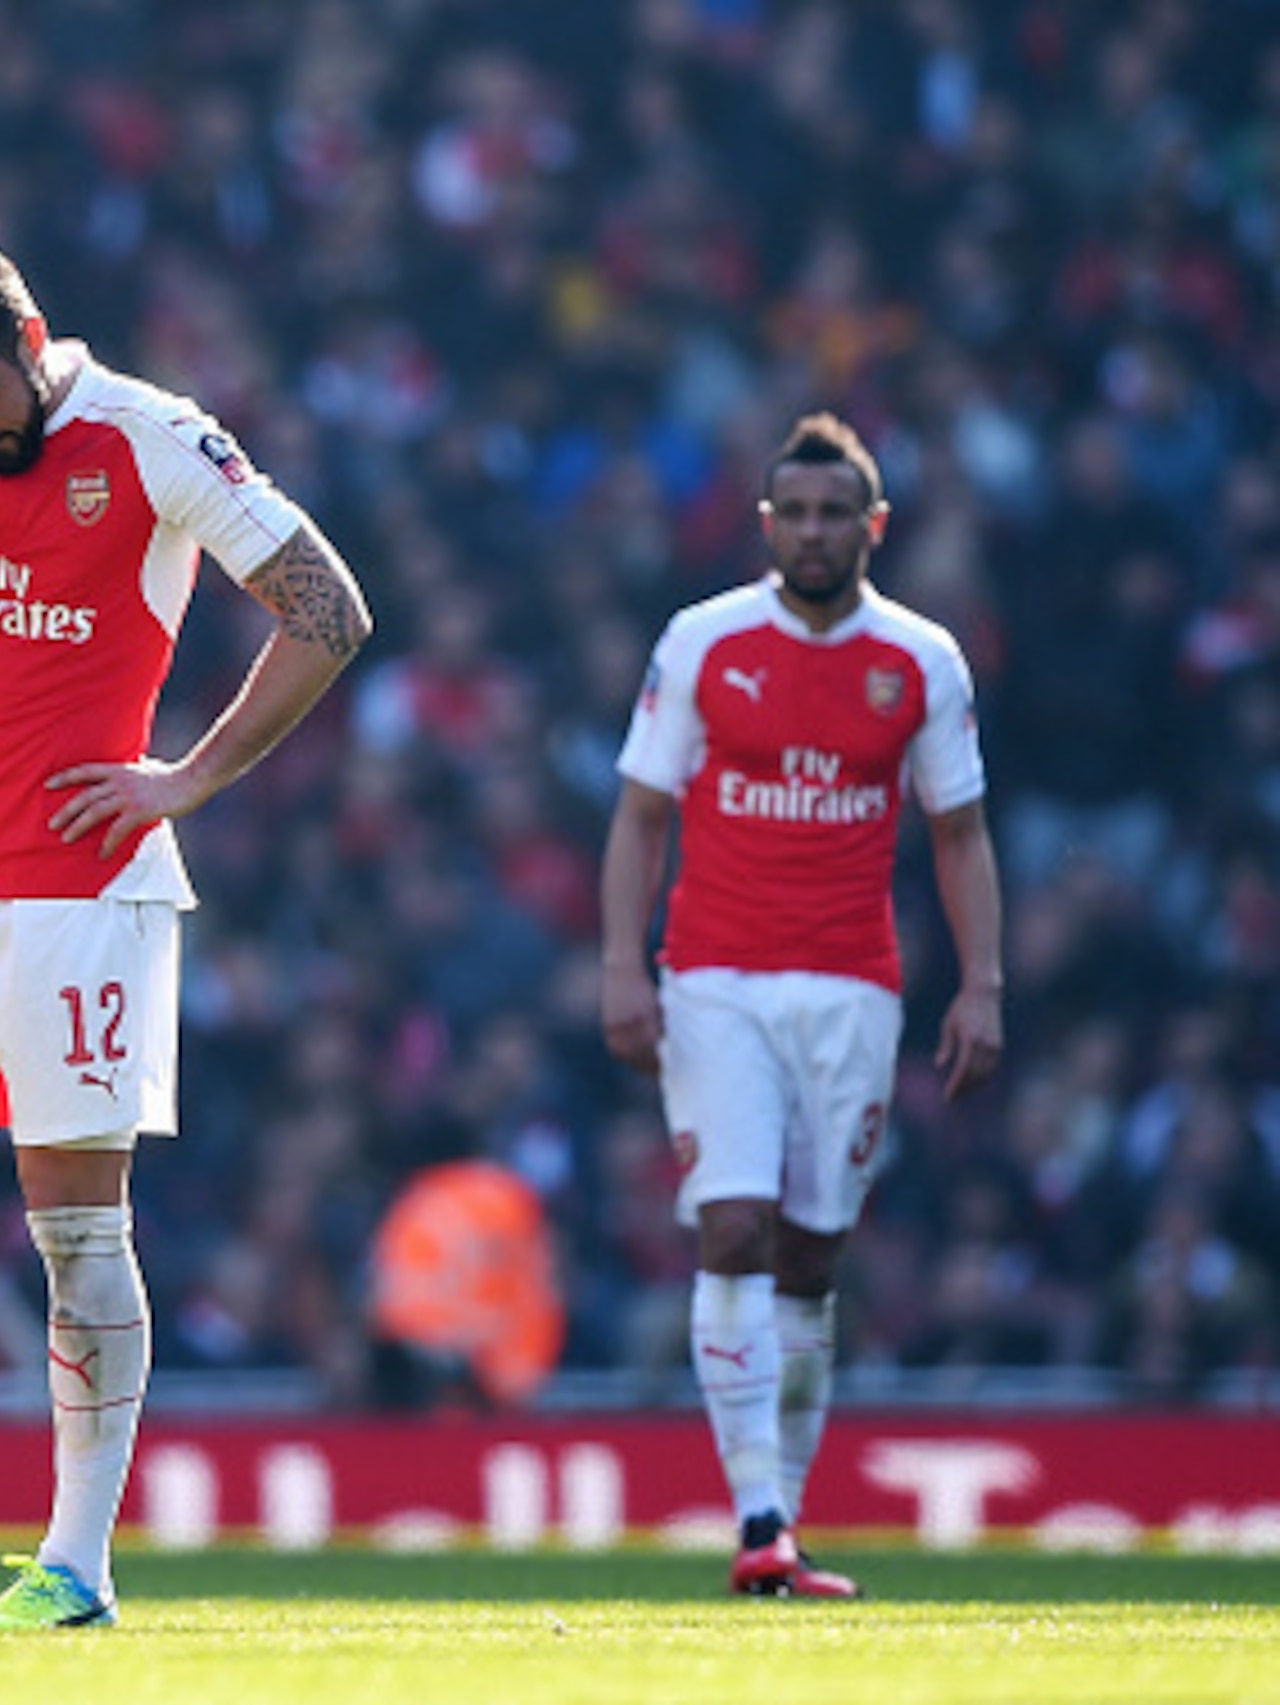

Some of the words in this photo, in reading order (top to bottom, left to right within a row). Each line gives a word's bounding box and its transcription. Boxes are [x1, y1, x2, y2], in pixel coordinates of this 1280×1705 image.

[781, 746, 840, 783] Fly
[718, 768, 888, 826] Emirates
[59, 981, 126, 1067] 12
